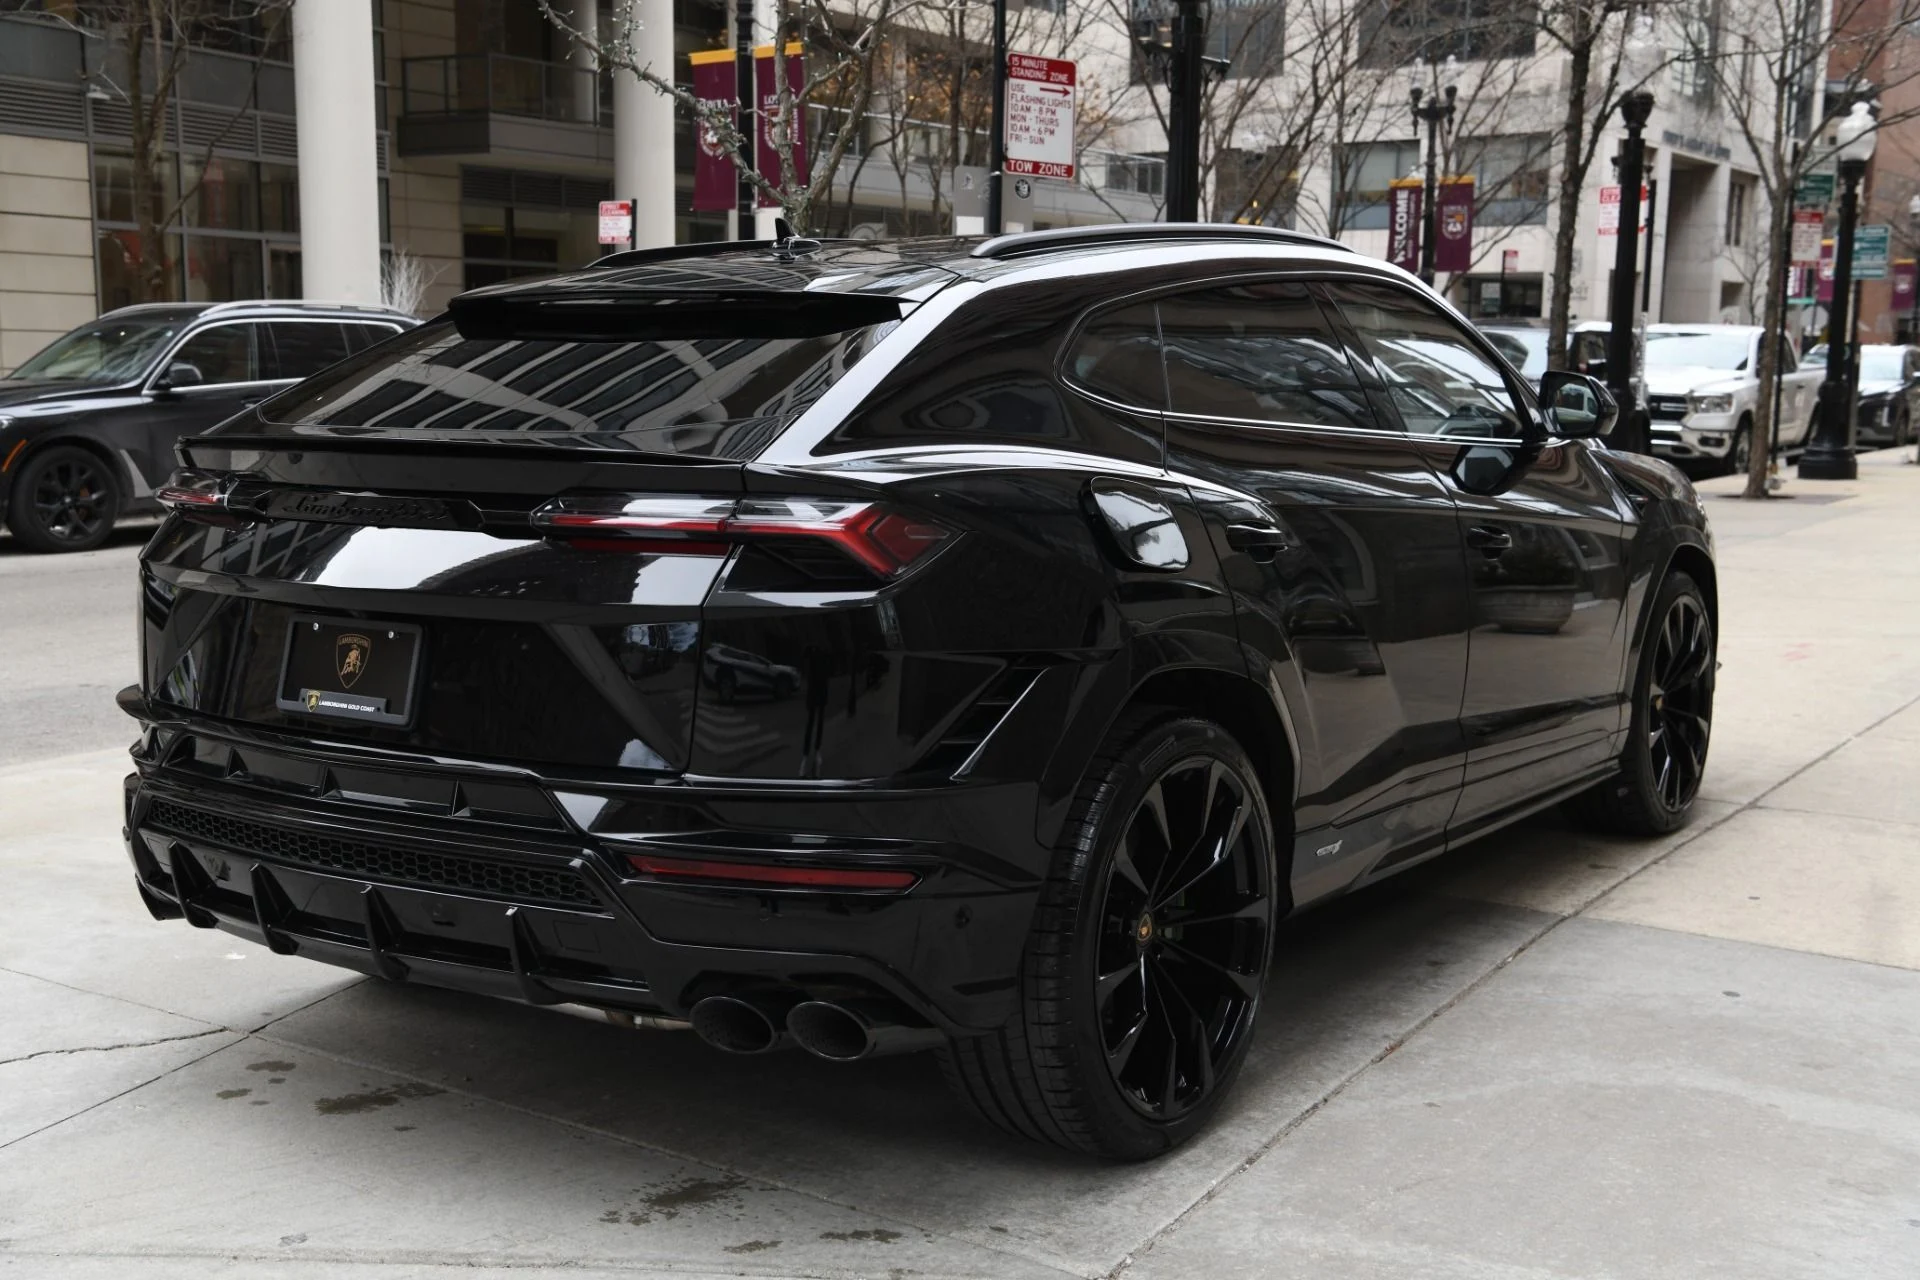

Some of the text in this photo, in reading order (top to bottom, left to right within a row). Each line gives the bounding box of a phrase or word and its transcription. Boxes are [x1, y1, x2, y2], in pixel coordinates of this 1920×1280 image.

[1011, 56, 1048, 70] 15 MINUTE
[1011, 67, 1069, 84] STANDING ZONE
[1011, 84, 1025, 93] USE
[1010, 93, 1072, 110] FLASHING LIGHTS
[1039, 106, 1043, 115] 8
[1010, 113, 1026, 122] MON
[1036, 115, 1059, 127] THURS
[1038, 127, 1043, 135] 6
[1010, 133, 1022, 143] FRI
[1029, 135, 1045, 144] SUN
[1009, 160, 1068, 177] TOW ZONE
[282, 495, 450, 523] Lamborghini
[318, 700, 375, 713] LAMBORGHINI GOLD COAST
